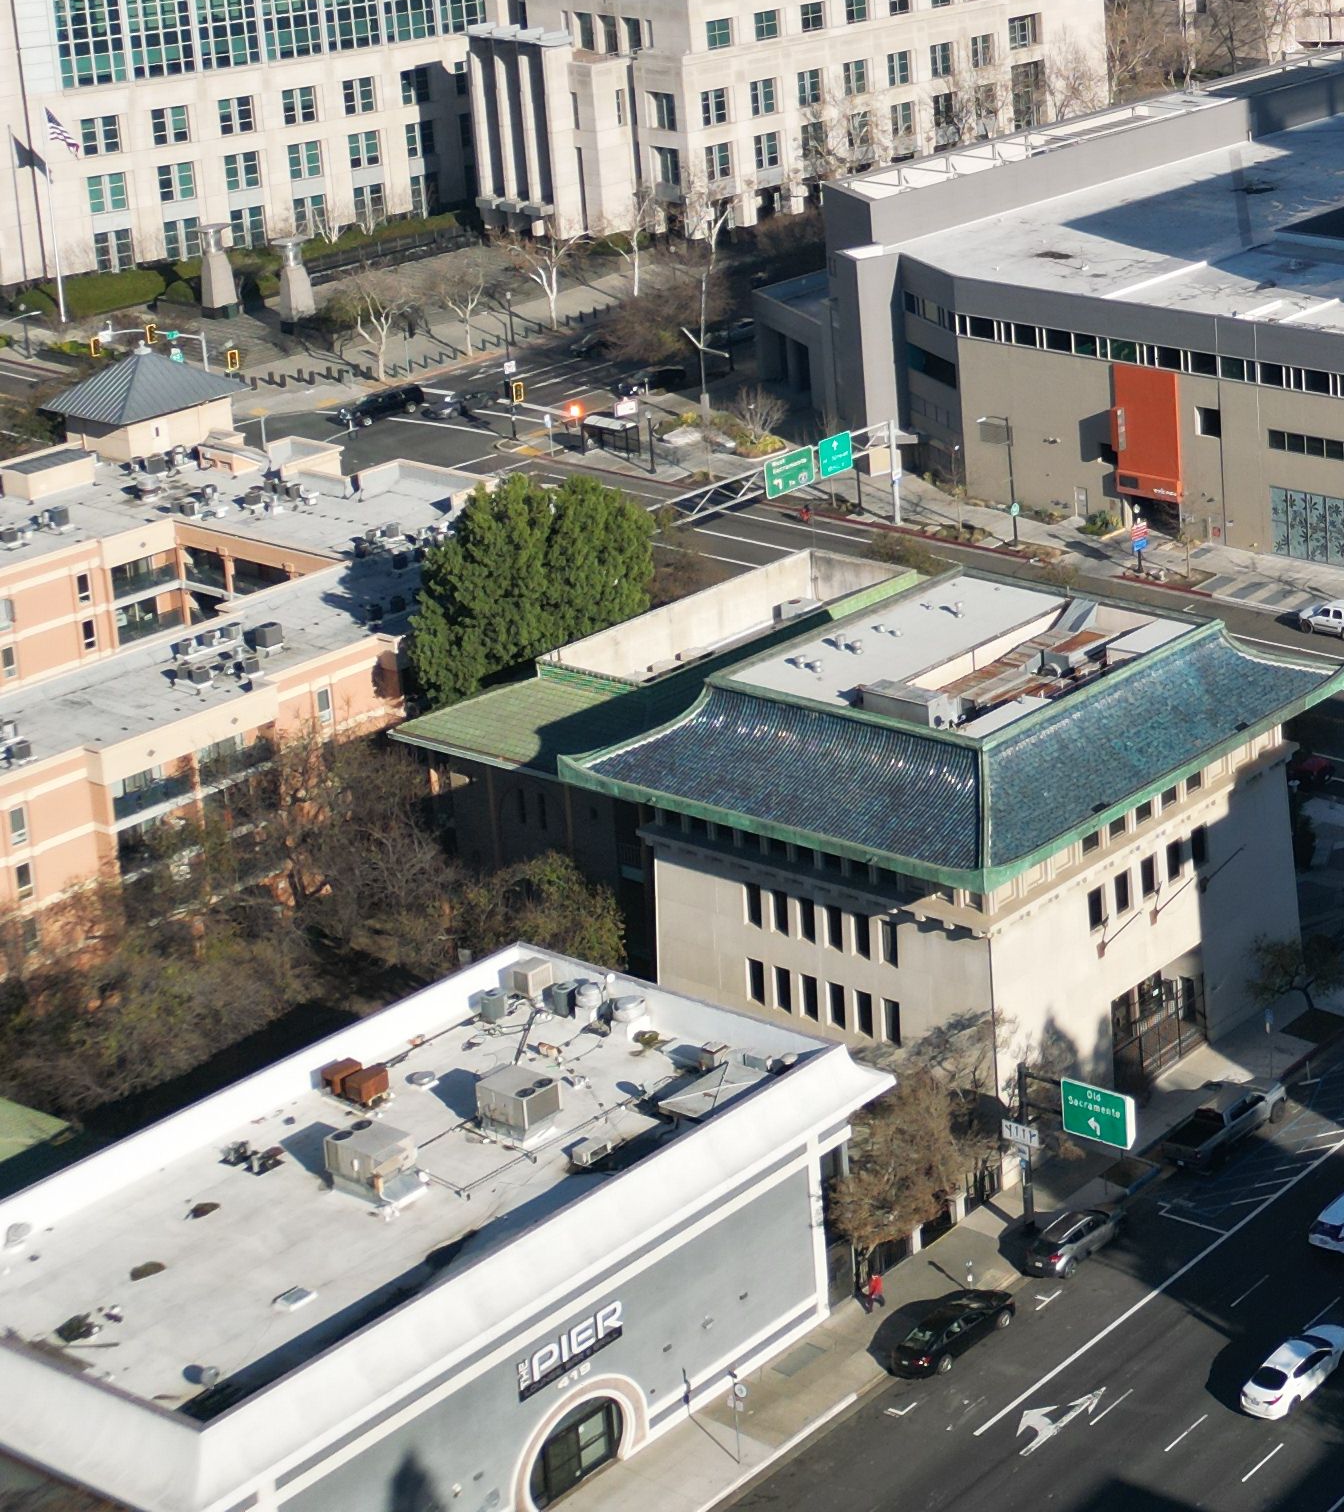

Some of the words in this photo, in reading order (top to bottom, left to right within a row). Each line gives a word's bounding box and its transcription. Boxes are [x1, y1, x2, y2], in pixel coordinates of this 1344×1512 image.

[1067, 1095, 1121, 1119] Sacramento
[1086, 1089, 1101, 1102] Old
[531, 1300, 623, 1383] PIER
[517, 1358, 530, 1391] THE
